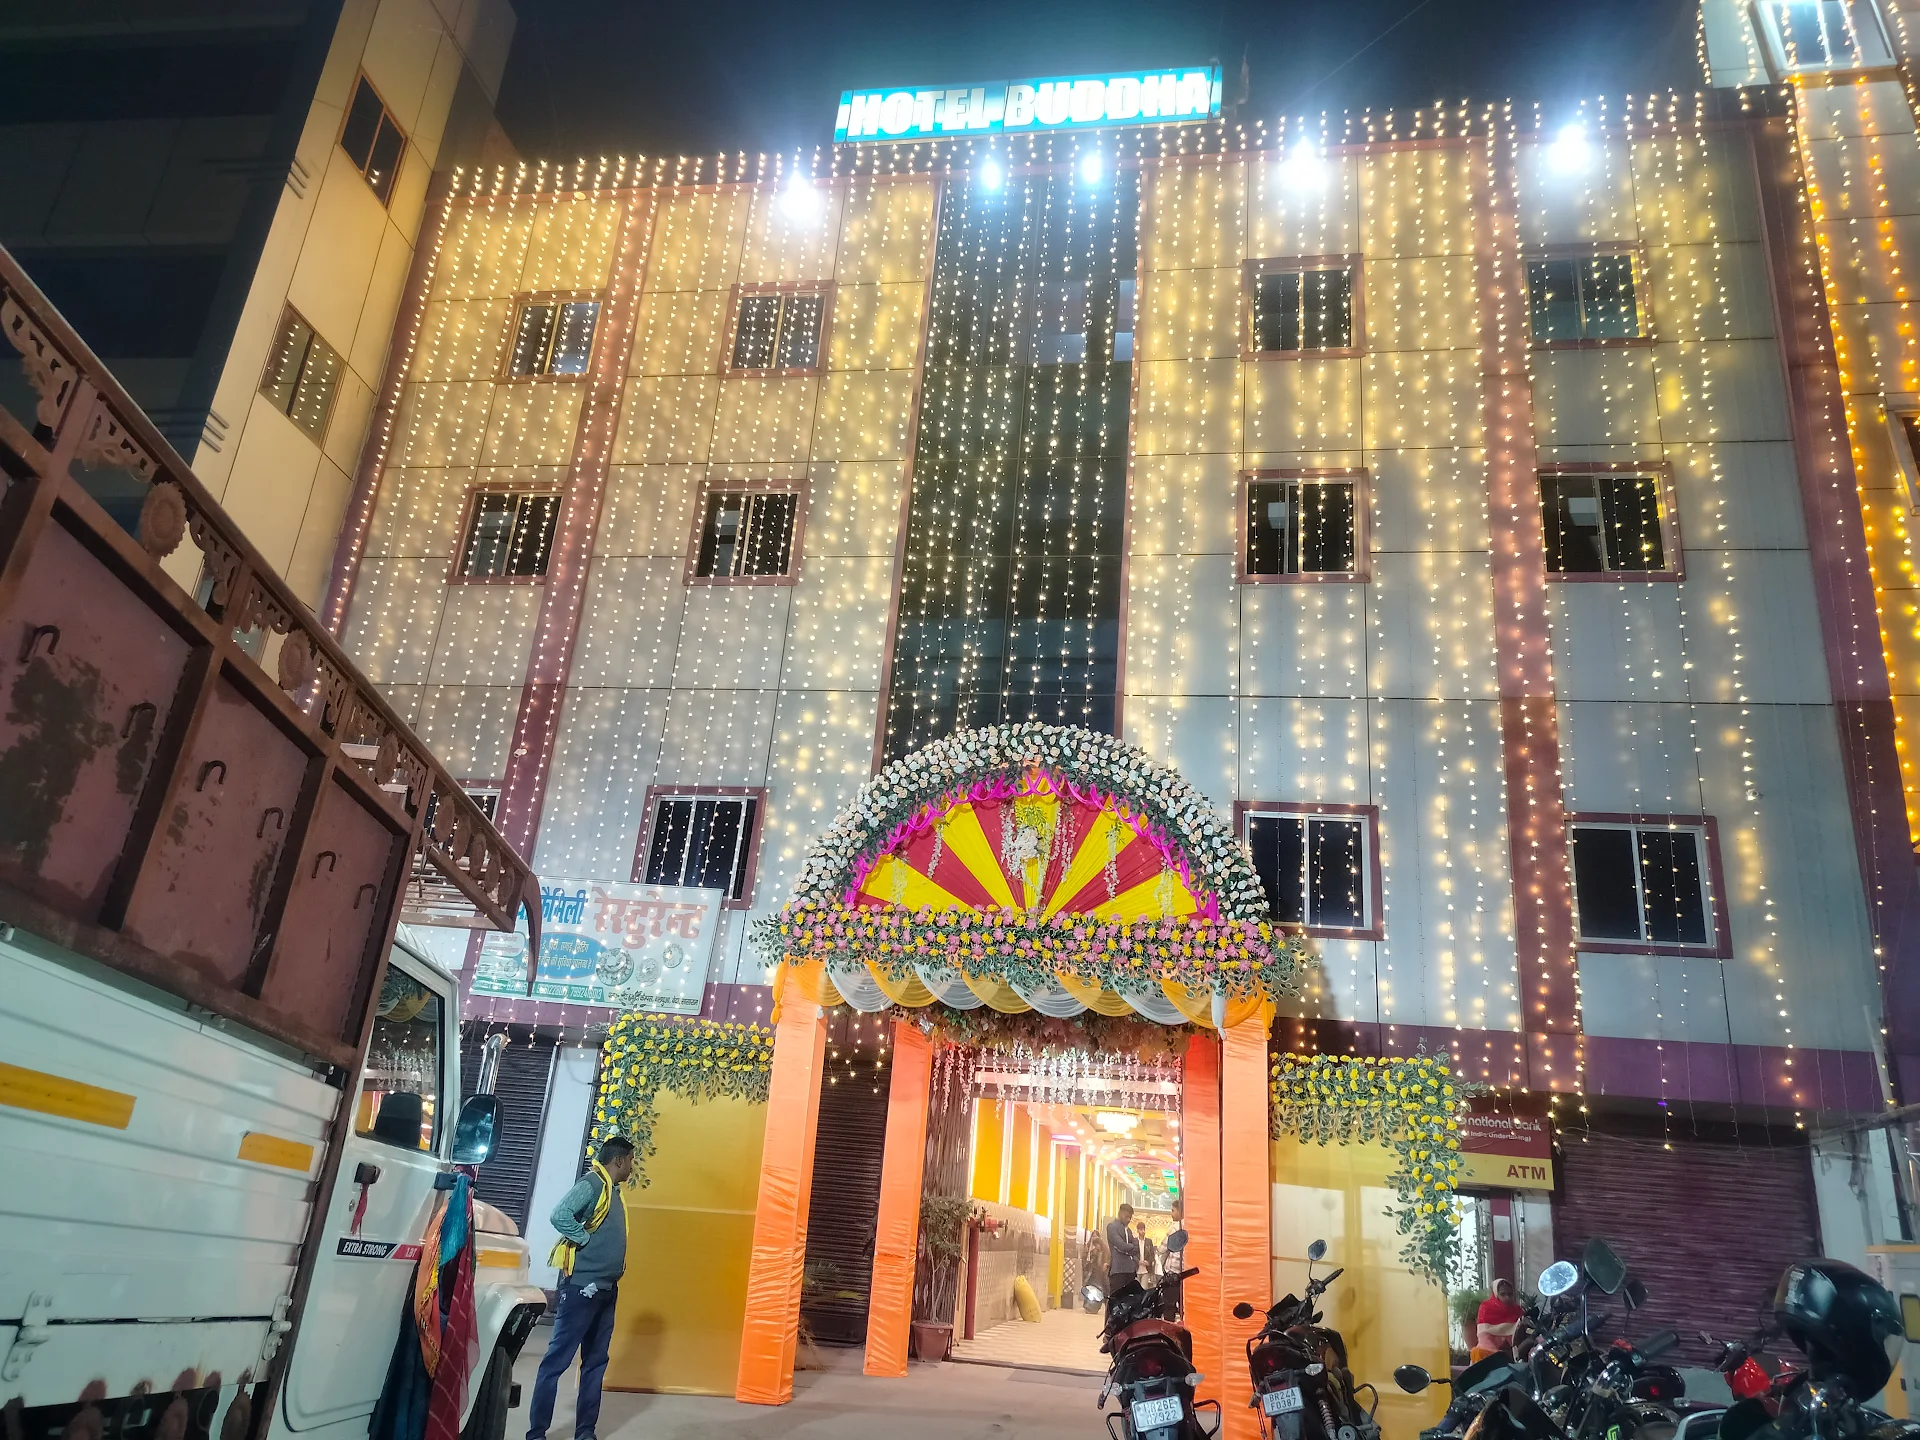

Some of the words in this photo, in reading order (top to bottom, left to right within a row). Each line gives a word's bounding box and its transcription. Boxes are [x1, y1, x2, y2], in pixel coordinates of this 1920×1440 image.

[847, 87, 991, 137] HOTEL
[1003, 73, 1212, 127] BUDDHA
[1467, 1116, 1512, 1129] national
[1514, 1118, 1541, 1132] bank
[1507, 1164, 1546, 1181] ATM
[342, 1242, 362, 1254] EXTRA
[362, 1243, 387, 1256] STRONG
[1269, 1389, 1296, 1402] BR24A
[1270, 1397, 1296, 1411] F0387
